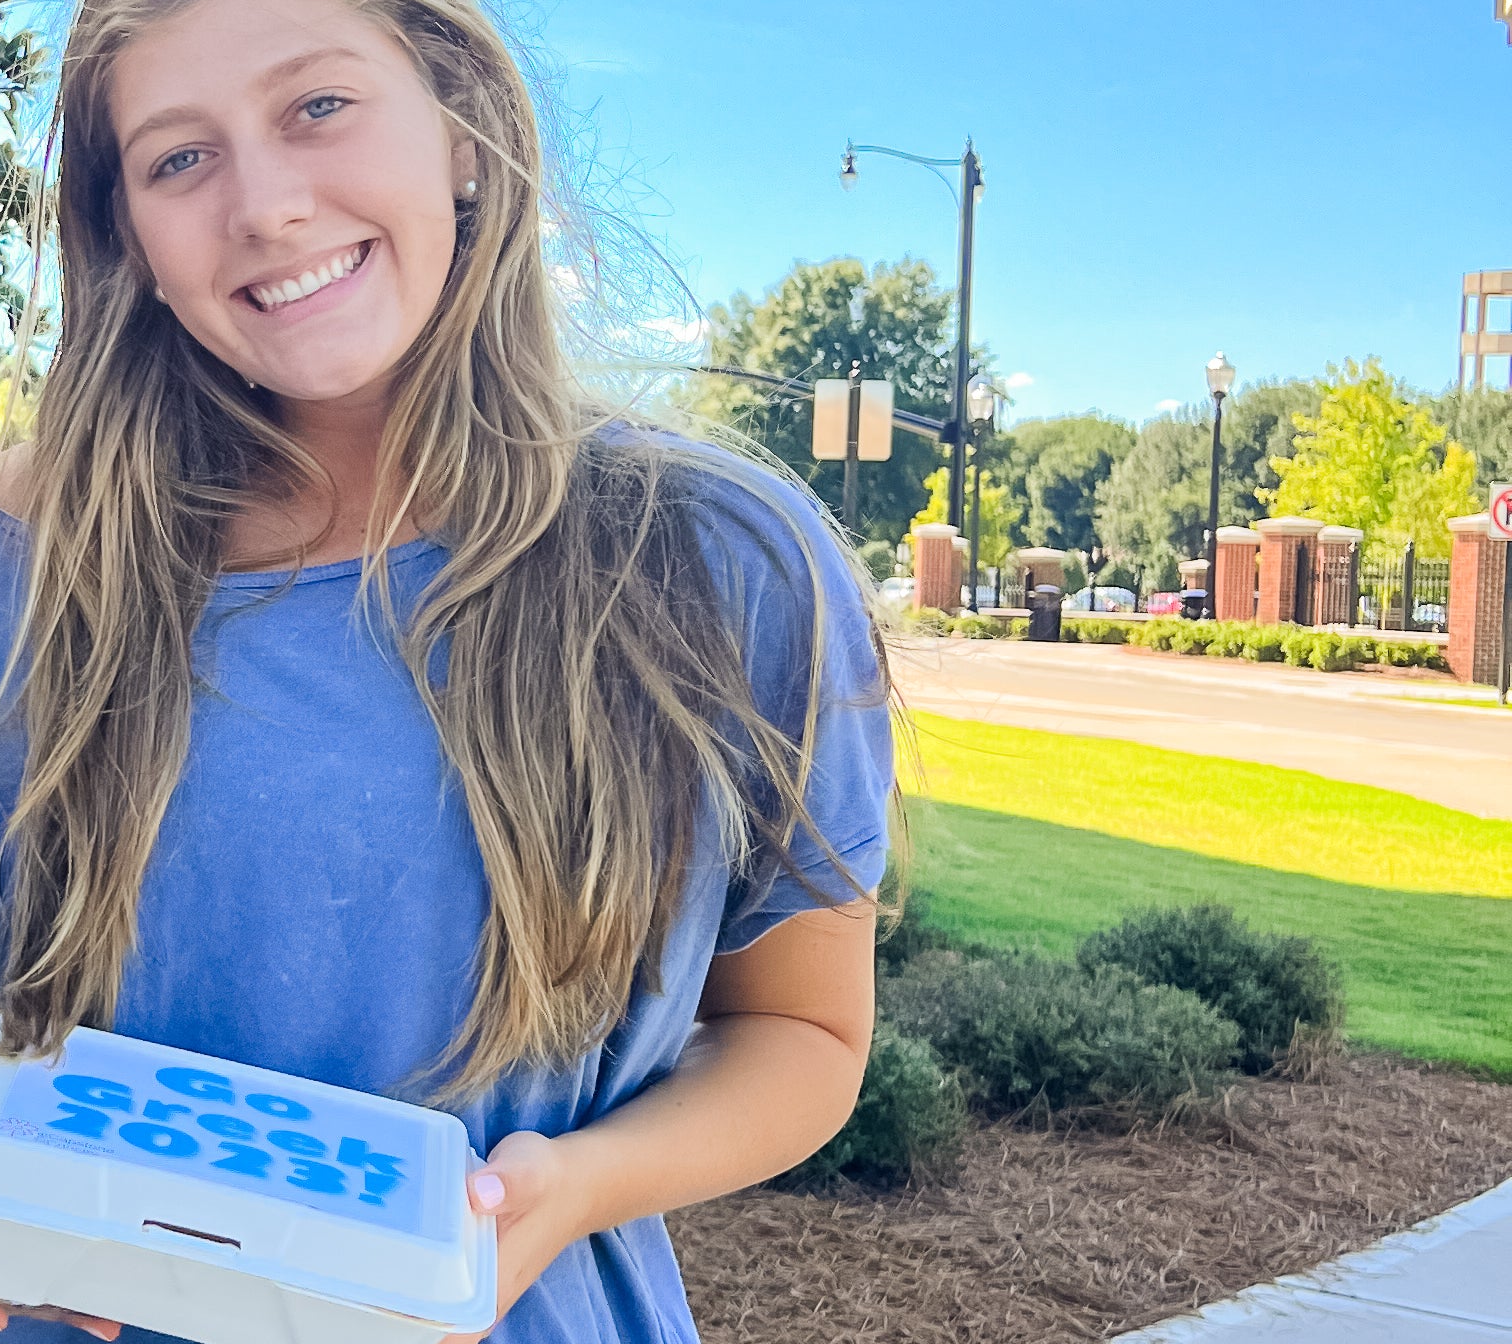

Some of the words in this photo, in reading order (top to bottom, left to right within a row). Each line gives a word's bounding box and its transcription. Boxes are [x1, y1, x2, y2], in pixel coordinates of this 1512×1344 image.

[52, 1074, 404, 1174] Greek
[155, 1066, 312, 1122] Go
[45, 1101, 406, 1208] 2023!
